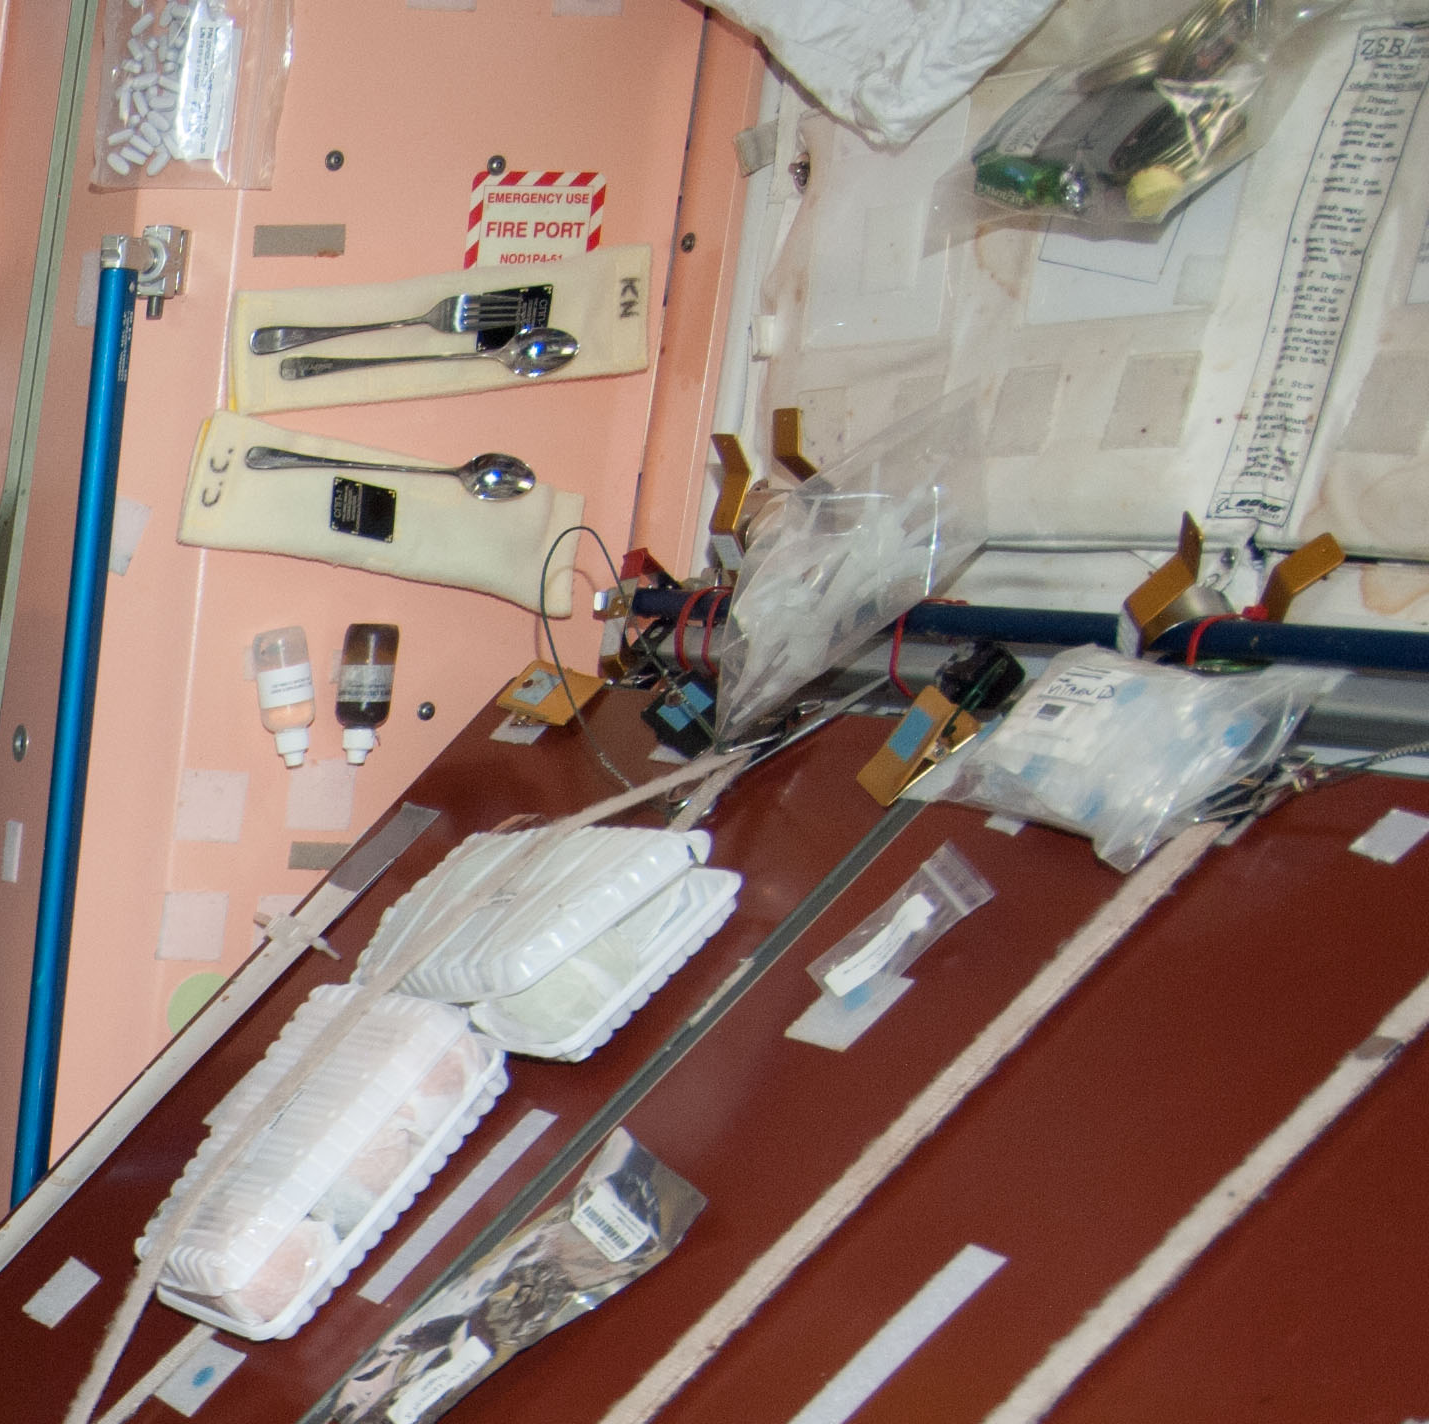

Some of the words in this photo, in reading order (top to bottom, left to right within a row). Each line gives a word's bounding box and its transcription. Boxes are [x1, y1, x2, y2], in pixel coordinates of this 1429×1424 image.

[487, 192, 562, 204] EMERGENCY
[565, 192, 590, 204] USE
[485, 221, 528, 238] FIRE
[533, 221, 586, 238] PORT
[619, 276, 641, 319] KN
